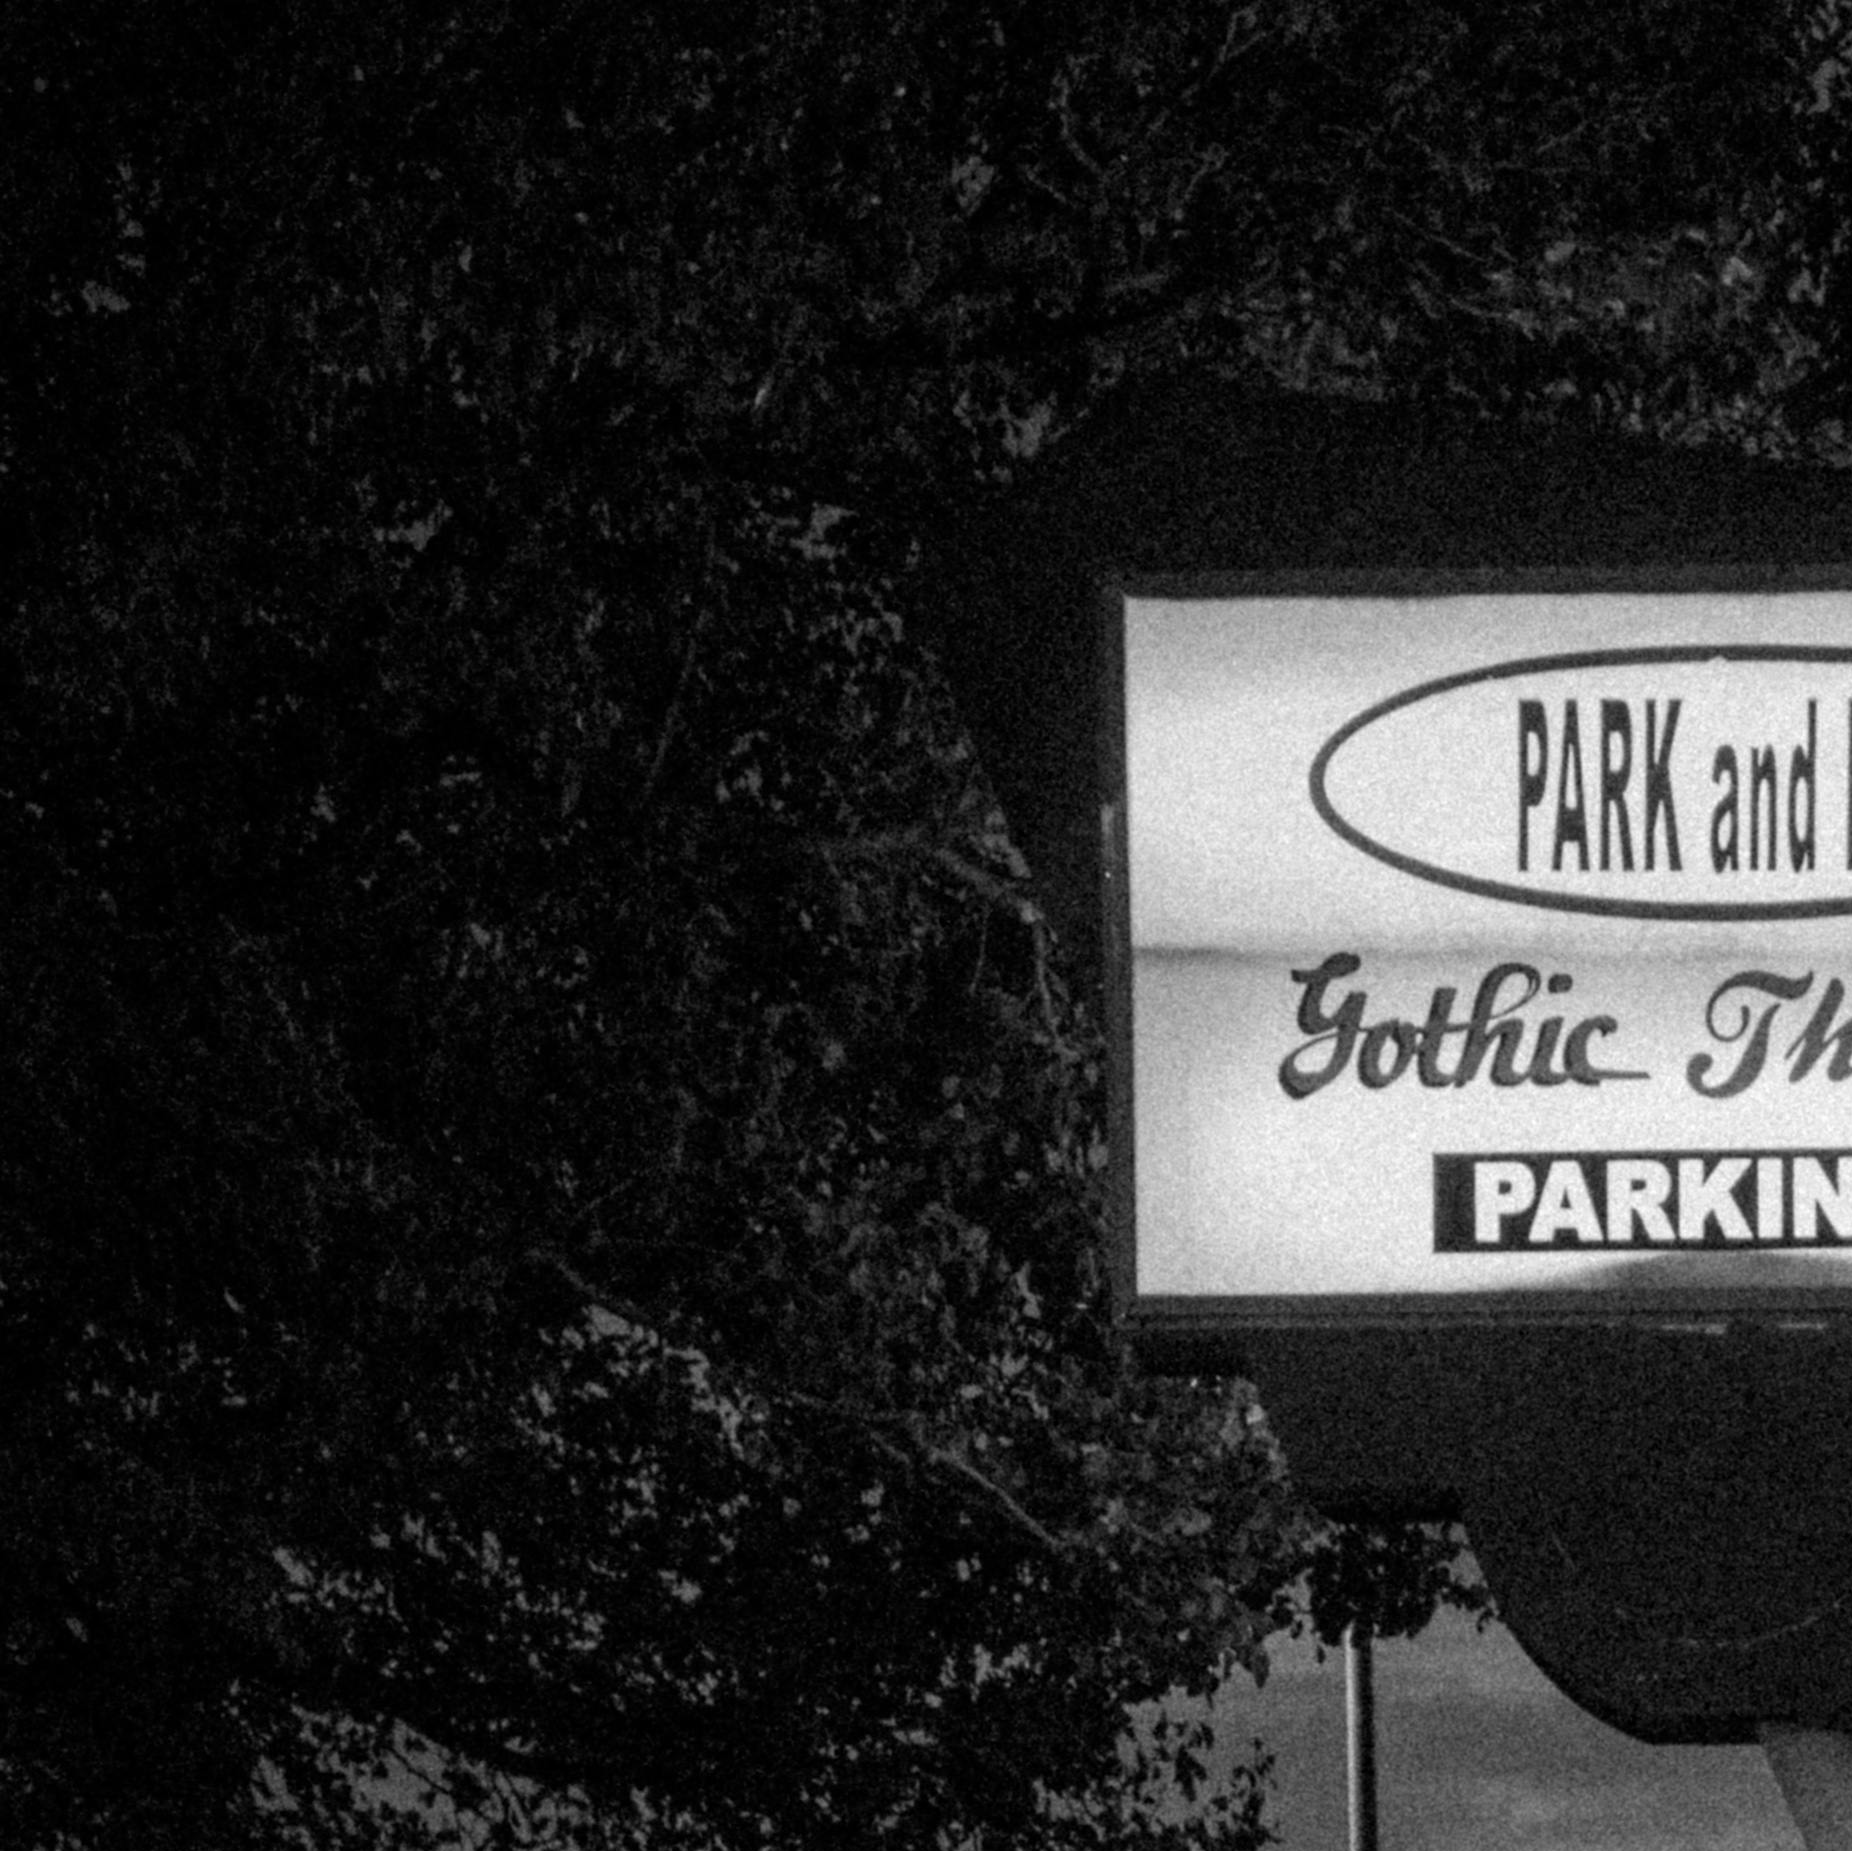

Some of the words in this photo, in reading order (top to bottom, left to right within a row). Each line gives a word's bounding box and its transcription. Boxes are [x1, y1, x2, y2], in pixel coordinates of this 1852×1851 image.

[1517, 698, 1683, 872] PARK
[1710, 699, 1817, 874] and
[1278, 950, 1649, 1101] Gothic
